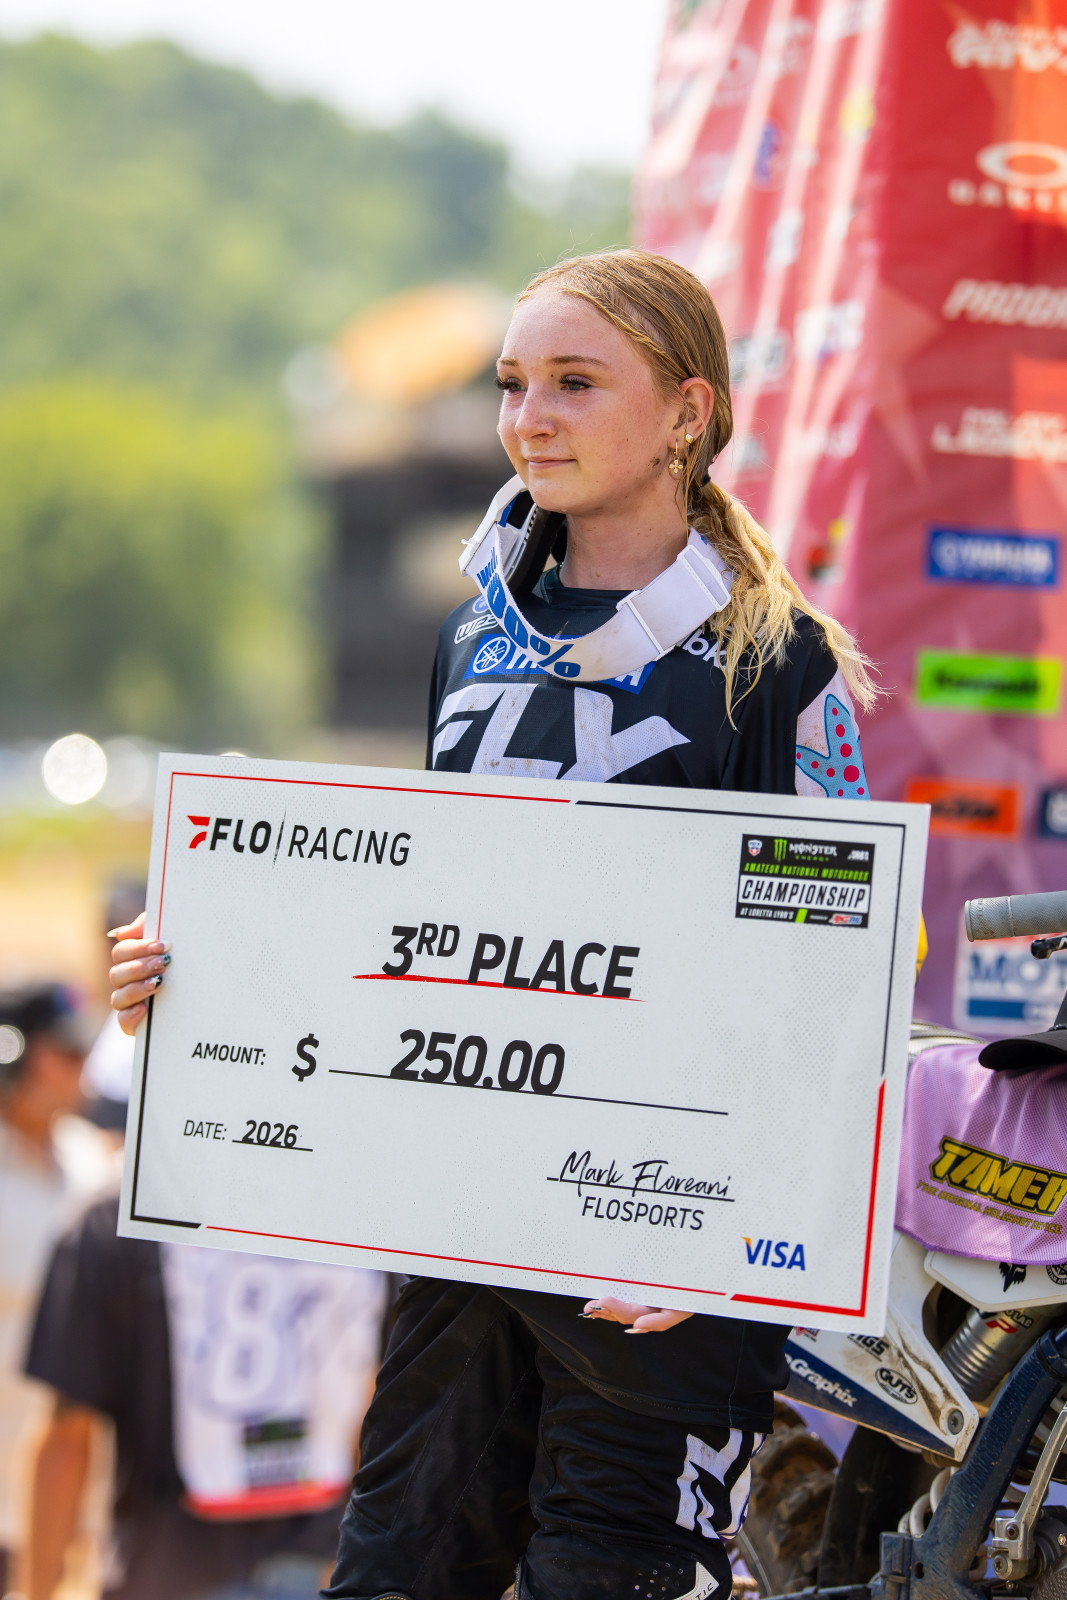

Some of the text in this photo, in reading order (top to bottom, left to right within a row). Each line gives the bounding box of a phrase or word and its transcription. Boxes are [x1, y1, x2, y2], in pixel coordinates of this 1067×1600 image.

[433, 683, 692, 783] FLY
[209, 817, 412, 867] FLO RACING
[788, 841, 838, 857] MONSTER
[744, 862, 780, 874] AMATEUR
[781, 865, 820, 877] NATIONAL
[742, 879, 866, 909] CHAMPIONSHIP
[381, 922, 641, 999] 3RD PLACE
[191, 1028, 566, 1096] AMOUNT: $ 250.00
[183, 1119, 299, 1148] DATE: 2026
[559, 1150, 733, 1198] Mark Floreani
[581, 1195, 705, 1232] FLOSPORTS
[740, 1236, 807, 1272] VISA
[880, 1367, 918, 1399] GUTS
